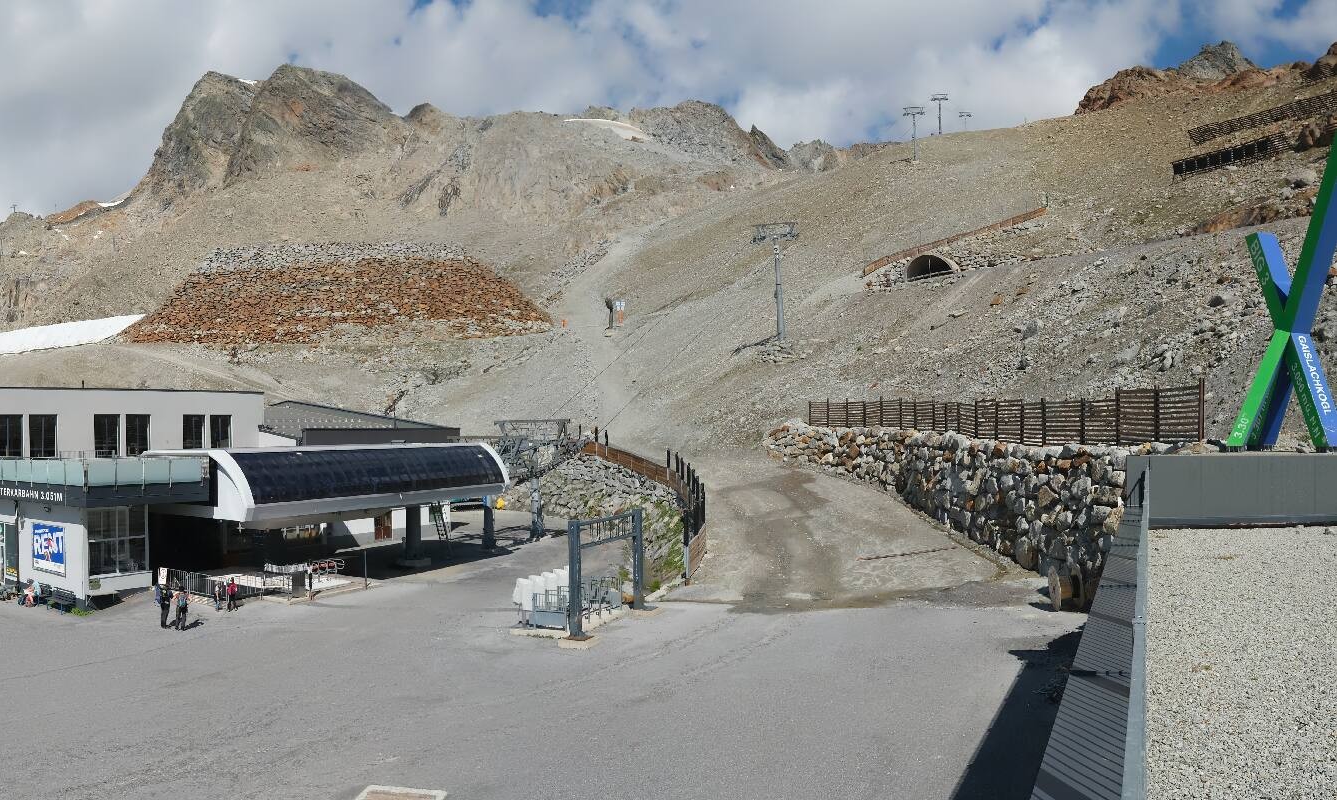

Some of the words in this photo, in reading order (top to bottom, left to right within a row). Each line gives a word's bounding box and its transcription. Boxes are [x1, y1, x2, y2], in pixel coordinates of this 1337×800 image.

[1251, 238, 1265, 272] BIG
[1261, 272, 1270, 285] 3
[1298, 335, 1332, 416] GAISLACHKOGL
[33, 531, 64, 556] RENT
